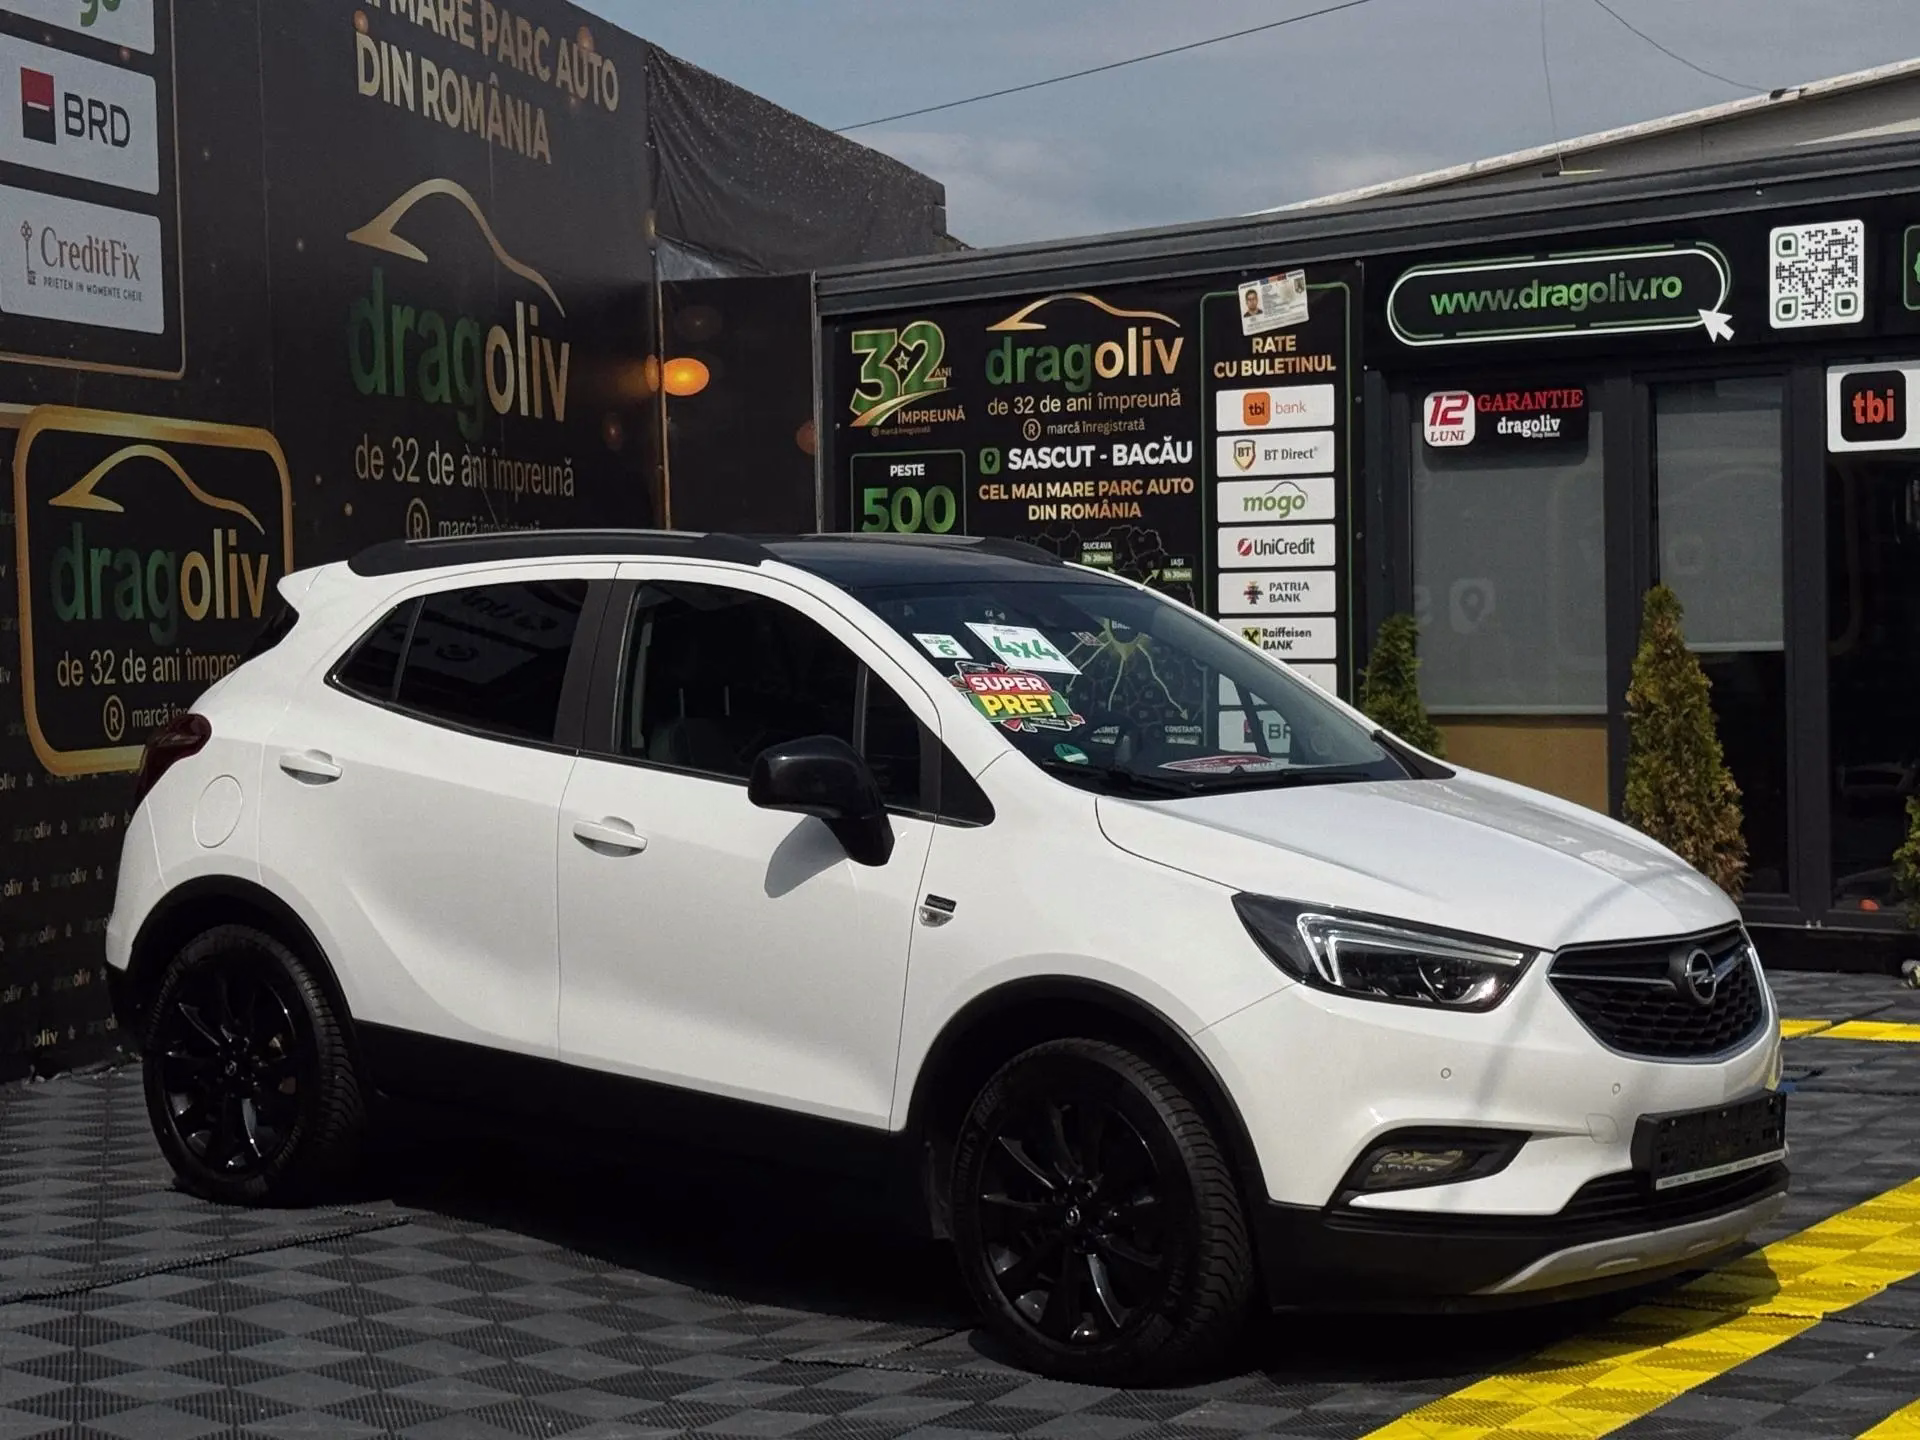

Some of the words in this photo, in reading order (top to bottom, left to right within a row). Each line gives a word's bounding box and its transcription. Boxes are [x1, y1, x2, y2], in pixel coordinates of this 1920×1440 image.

[482, 0, 551, 82] PARC
[556, 37, 619, 112] AUTO
[356, 32, 415, 112] DIN
[420, 56, 551, 164] ROMÂNIA
[64, 92, 131, 148] BRD
[41, 227, 140, 281] CreditFix
[44, 276, 73, 290] PRIETEN
[87, 284, 121, 299] MOMENTE
[1431, 272, 1682, 316] www.dragoliv.ro
[350, 266, 570, 441] dragoliv
[1252, 335, 1296, 353] RATE
[849, 320, 945, 416] 32
[985, 327, 1184, 393] dragoliv
[1214, 361, 1237, 378] CU
[1241, 354, 1336, 376] BULETINUL
[988, 397, 1009, 415] de
[1014, 396, 1034, 414] 32
[1040, 393, 1061, 413] de
[1067, 393, 1092, 412] ani
[1098, 388, 1181, 414] împreună
[1248, 402, 1266, 416] tbi
[1275, 402, 1306, 415] bank
[1429, 394, 1469, 427] 12
[1477, 389, 1584, 412] GARANTIE
[1853, 389, 1895, 424] tbi
[1047, 424, 1080, 435] marcă
[1082, 417, 1145, 435] înregistrată
[1431, 431, 1465, 443] LUNI
[1497, 414, 1561, 438] dragoliv
[1008, 445, 1096, 471] SASCUT
[1112, 435, 1193, 467] BACĂU
[1237, 446, 1252, 457] BT
[1264, 450, 1279, 461] BT
[355, 434, 384, 481] de
[392, 437, 421, 483] 32
[427, 441, 454, 486] de
[461, 446, 487, 488] ani
[491, 447, 574, 502] împreună
[890, 463, 925, 477] PESTE
[979, 484, 1009, 500] CEL
[1012, 483, 1042, 498] MAI
[1047, 481, 1095, 498] MARE
[1099, 480, 1144, 497] PARC
[1147, 477, 1194, 496] AUTO
[861, 485, 956, 533] 500
[1028, 504, 1057, 521] DIN
[1061, 499, 1143, 520] ROMÂNIA
[1242, 494, 1306, 519] mogo
[1254, 537, 1315, 556] UniCredit
[51, 521, 269, 646] dragoliv
[1269, 581, 1310, 592] PATRIA
[1269, 593, 1301, 602] BANK
[1262, 627, 1312, 638] Raiffeisen
[938, 644, 958, 656] 6
[1263, 640, 1293, 650] BANK
[57, 651, 84, 687] de
[91, 649, 116, 686] 32
[122, 649, 146, 684] de
[152, 648, 180, 682] ani
[970, 677, 1046, 691] SUPER
